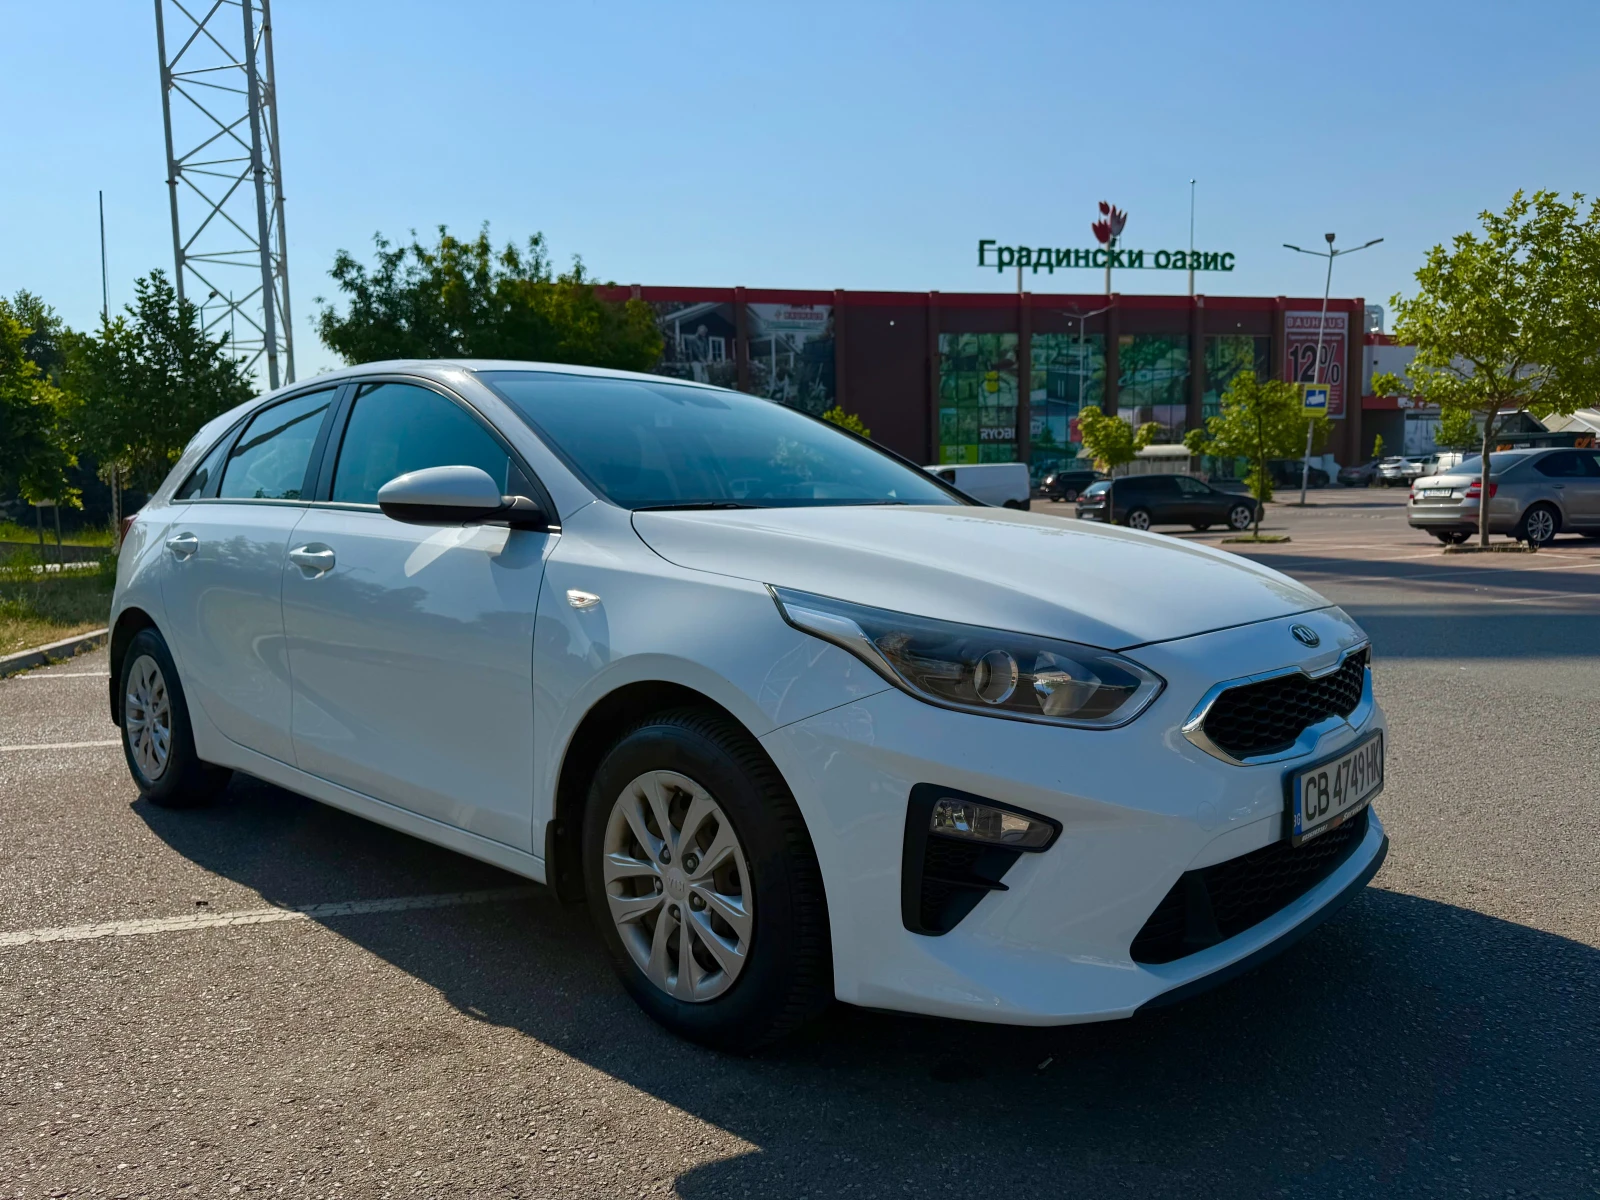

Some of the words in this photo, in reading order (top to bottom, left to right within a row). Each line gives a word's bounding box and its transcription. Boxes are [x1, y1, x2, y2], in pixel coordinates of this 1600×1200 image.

[978, 240, 1144, 274] Градински
[1154, 249, 1235, 271] оазис
[1289, 343, 1341, 385] 12%
[980, 428, 1015, 440] RYOBI
[1293, 627, 1317, 642] KIA
[1305, 772, 1329, 822] CB
[1333, 752, 1364, 806] 4749
[1366, 740, 1381, 786] HK
